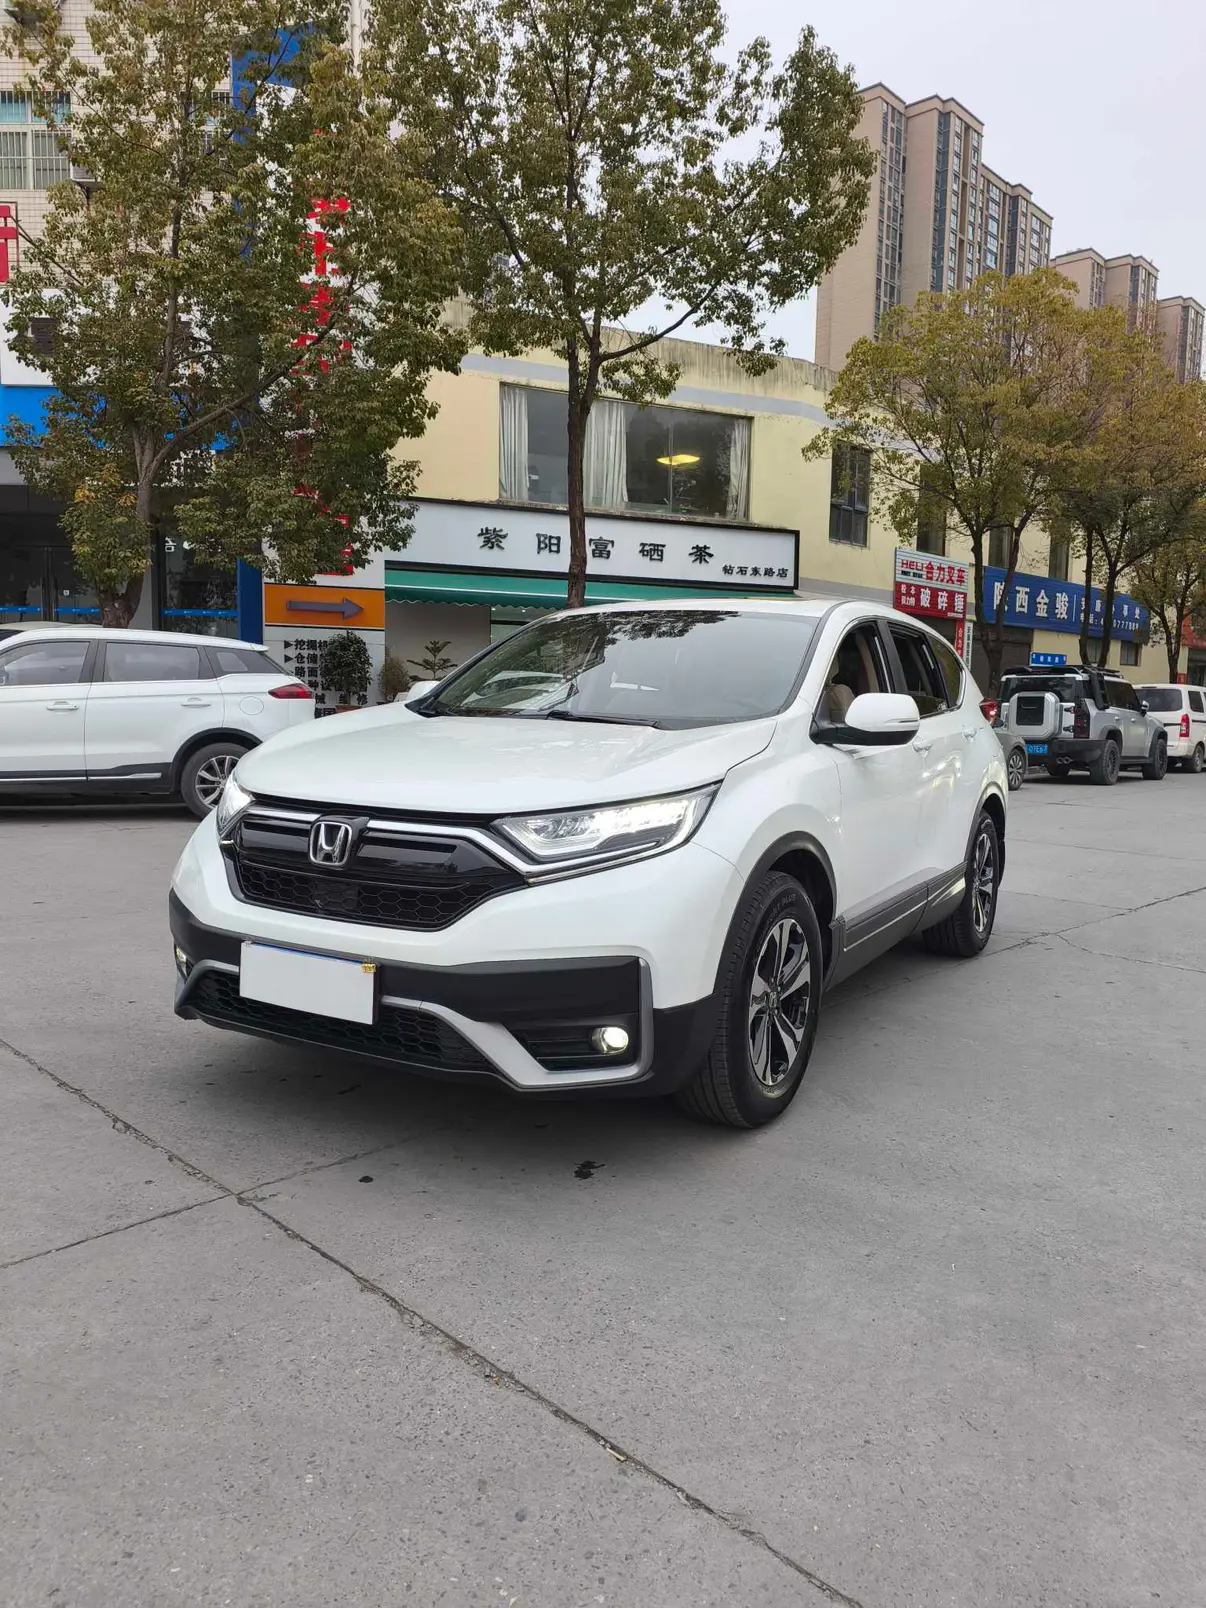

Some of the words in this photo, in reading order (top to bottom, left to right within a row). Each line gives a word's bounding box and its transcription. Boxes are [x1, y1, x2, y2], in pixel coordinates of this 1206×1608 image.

[477, 526, 714, 565] 紫阳富硒茶
[722, 564, 789, 578] 钻石东路店
[925, 561, 965, 585] 合力叉车
[920, 587, 964, 612] 破碎锤
